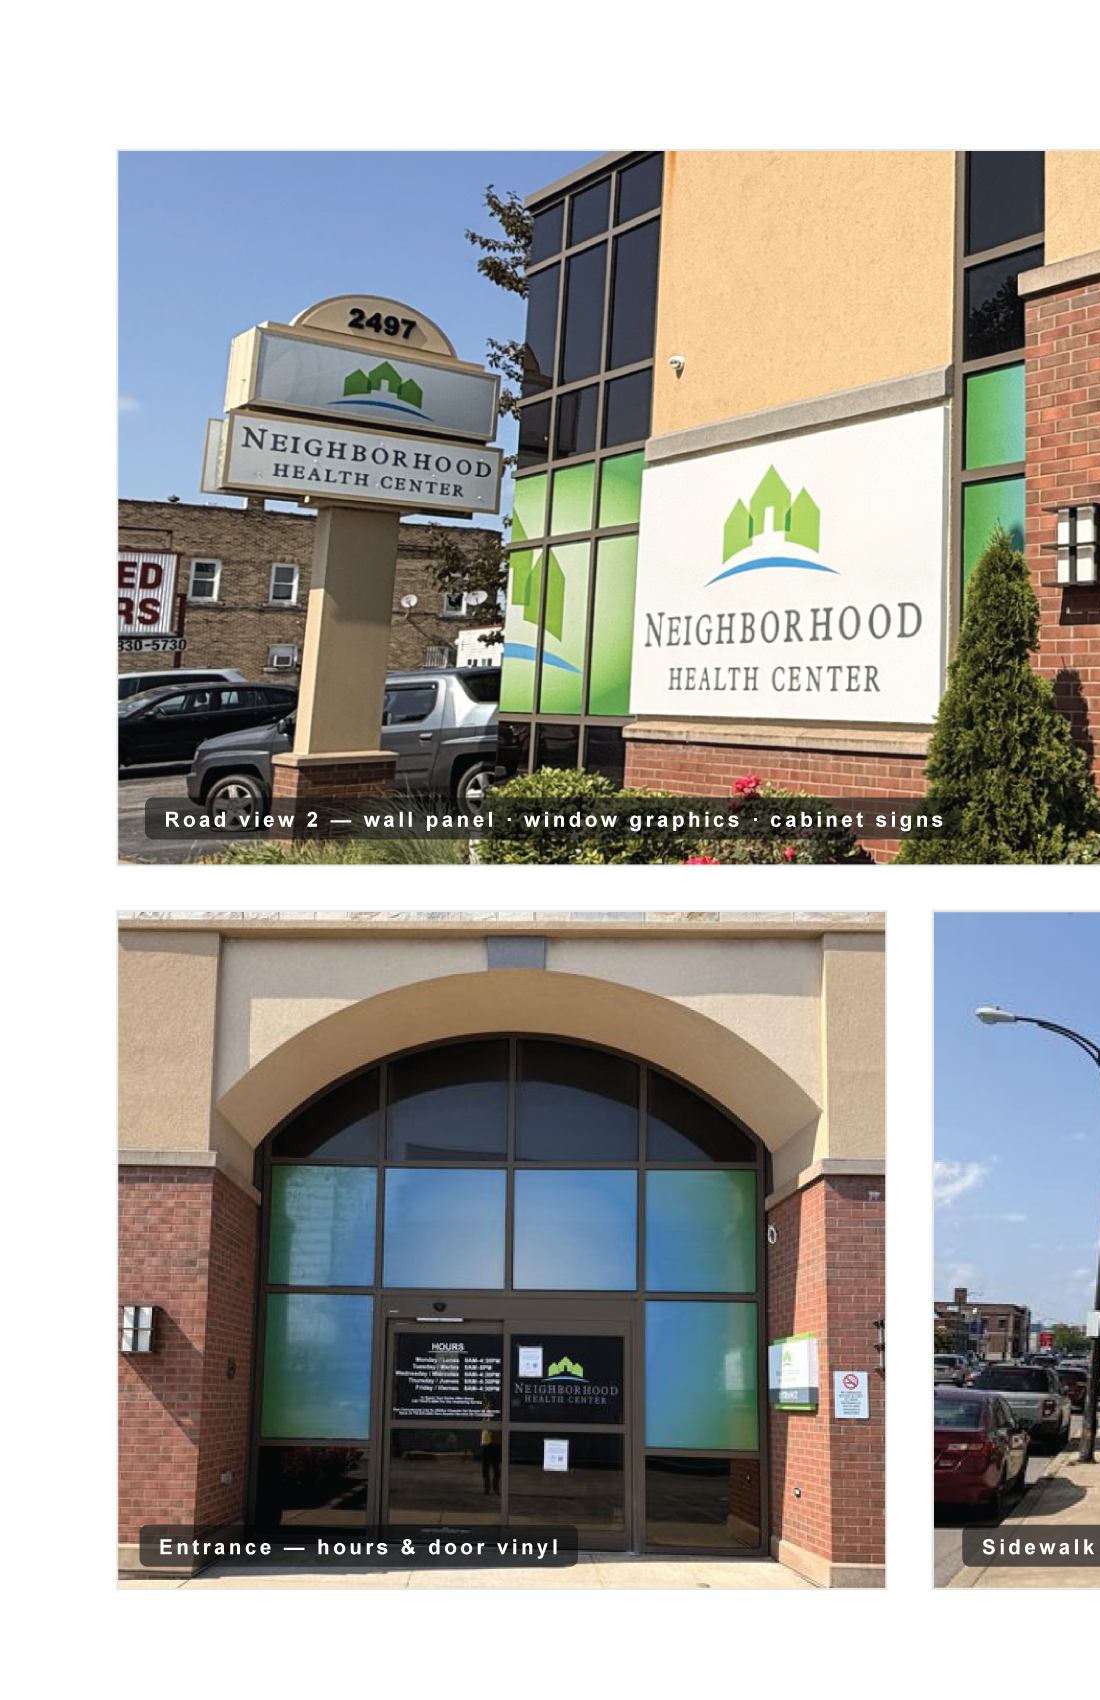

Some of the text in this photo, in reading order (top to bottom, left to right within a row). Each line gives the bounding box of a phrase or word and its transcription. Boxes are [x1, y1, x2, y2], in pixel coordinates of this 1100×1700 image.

[348, 308, 417, 340] 2497
[241, 426, 493, 479] NEIGHBORHOOD
[272, 463, 465, 498] HEALTH CENTER
[644, 602, 923, 648] NEIGHBORHOOD
[667, 665, 881, 692] HEALTH CENTER
[431, 1342, 465, 1352] HOURS
[514, 1382, 620, 1396] NEIGHBORHOOD
[524, 1395, 607, 1405] HEALTH CENTER
